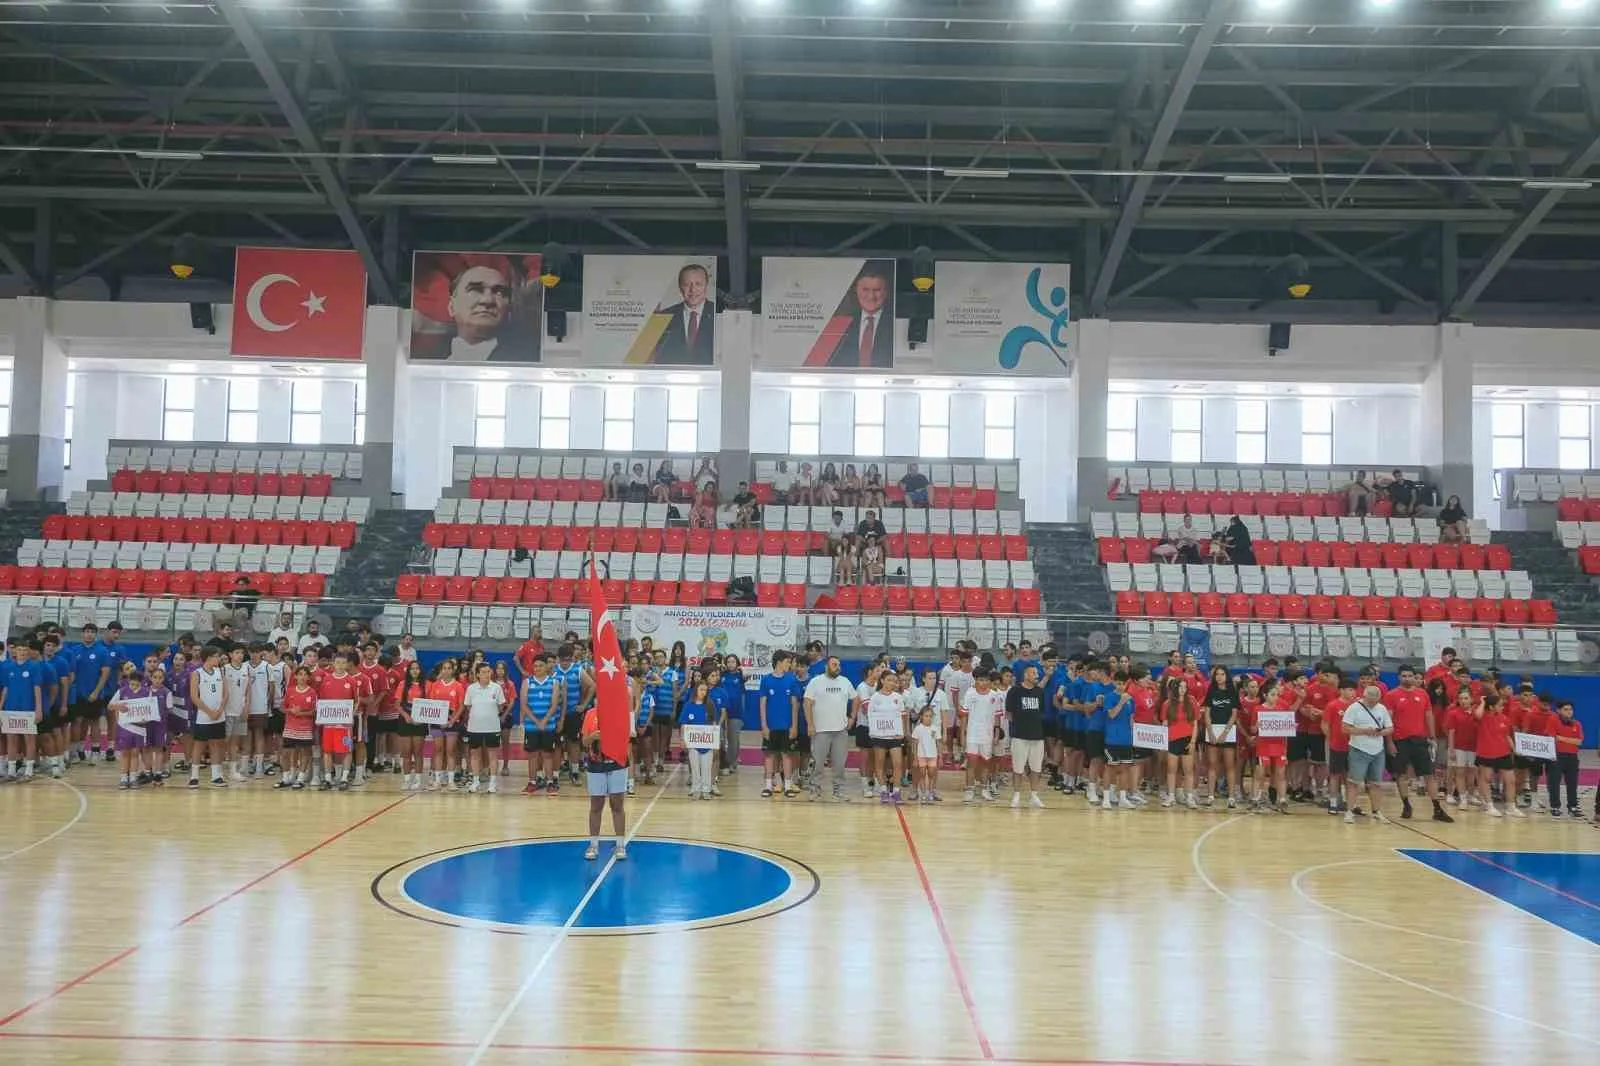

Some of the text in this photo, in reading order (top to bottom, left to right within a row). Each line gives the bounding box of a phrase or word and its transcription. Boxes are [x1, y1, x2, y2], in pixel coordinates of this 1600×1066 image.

[704, 610, 746, 618] YILDIZLAR
[320, 705, 350, 718] KÜTAHYA
[419, 706, 441, 718] AYDIN
